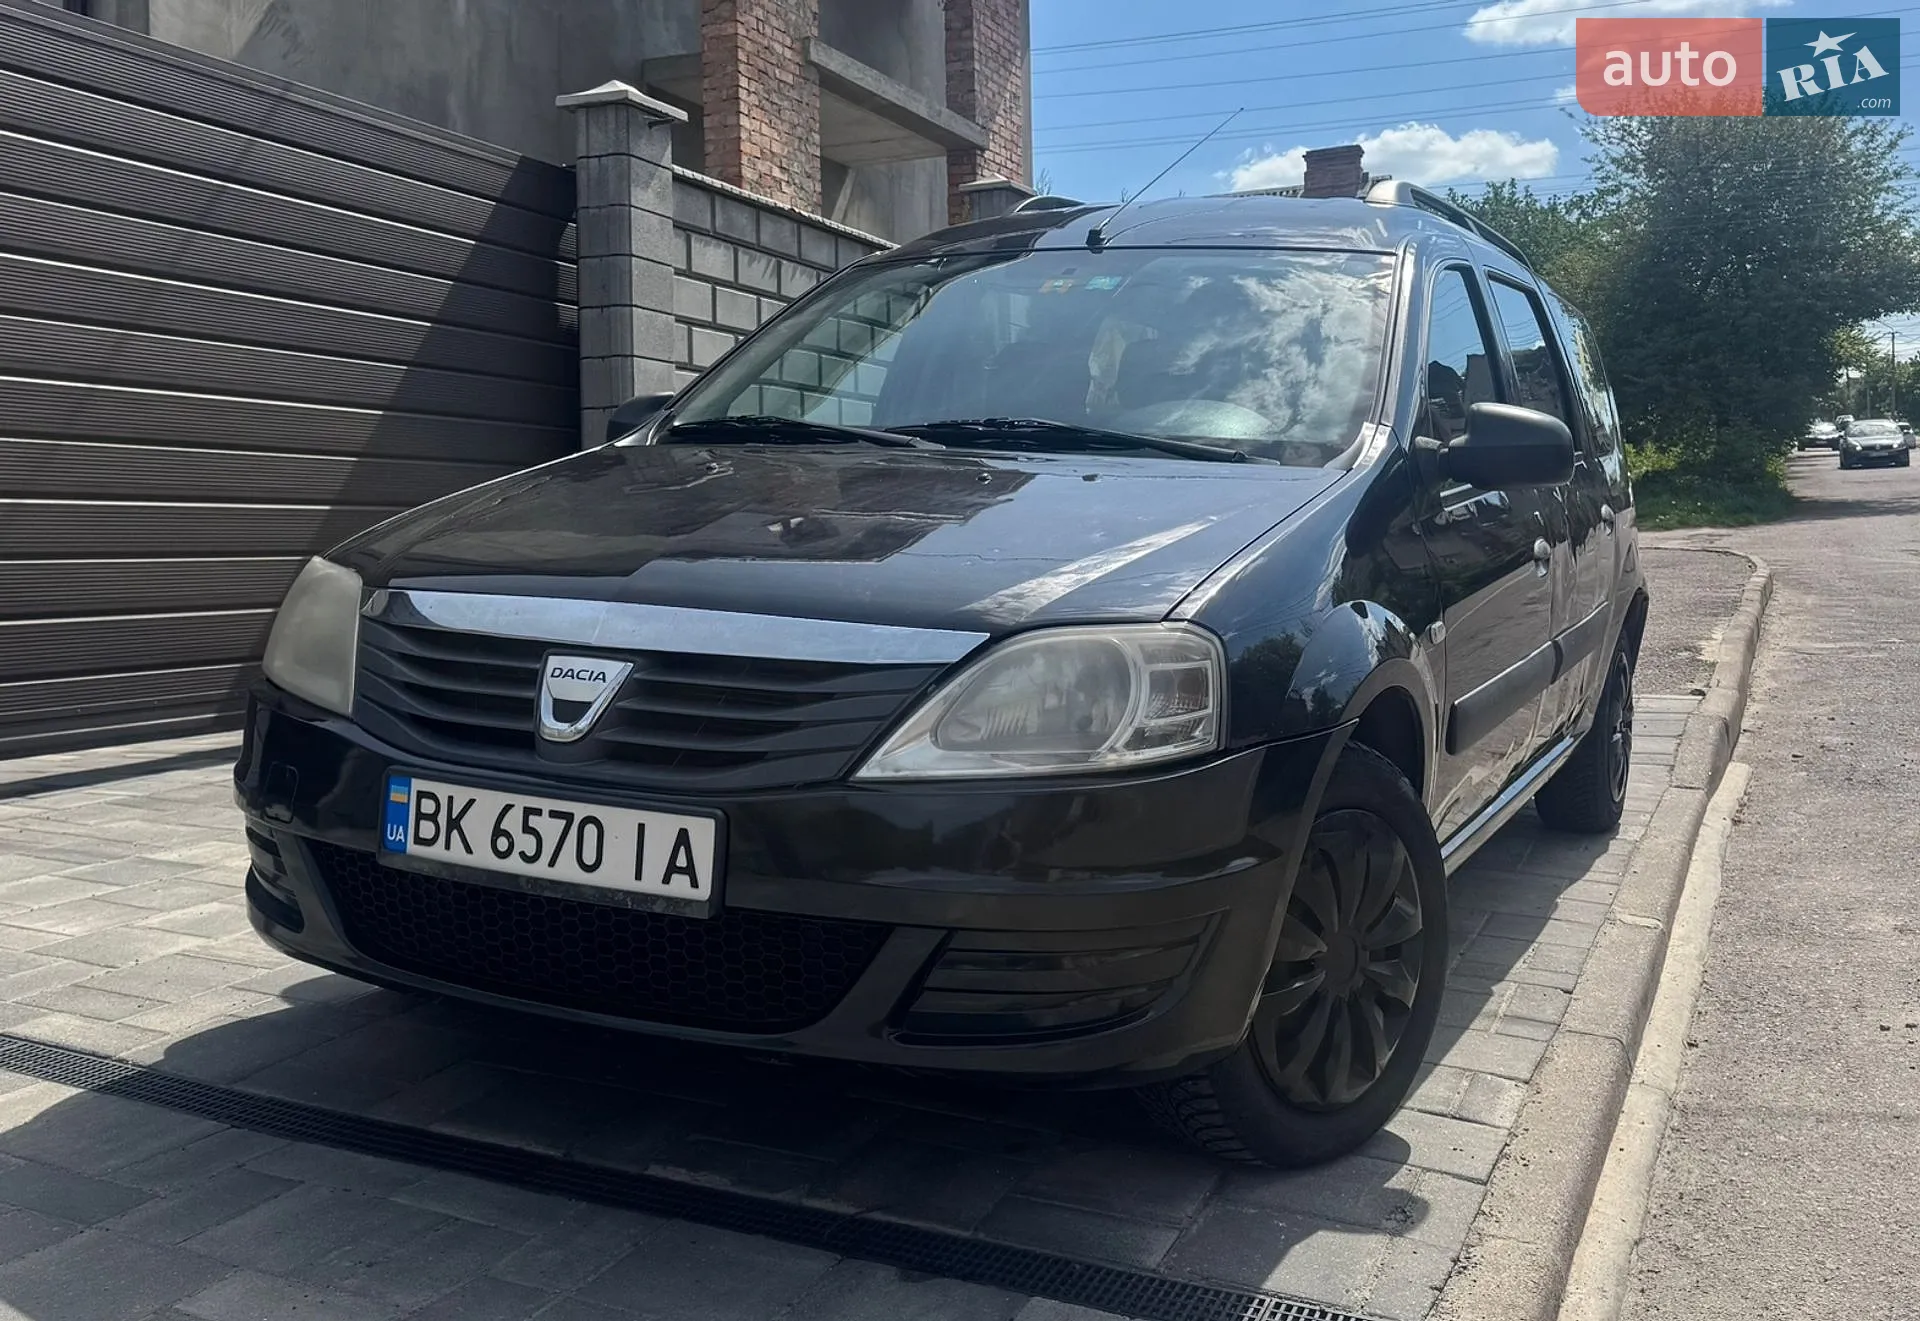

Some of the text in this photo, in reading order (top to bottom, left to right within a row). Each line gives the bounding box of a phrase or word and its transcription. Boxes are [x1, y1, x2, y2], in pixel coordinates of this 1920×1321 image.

[550, 667, 607, 683] DACIA
[386, 823, 405, 843] UA
[413, 790, 699, 888] BK 6570 IA
